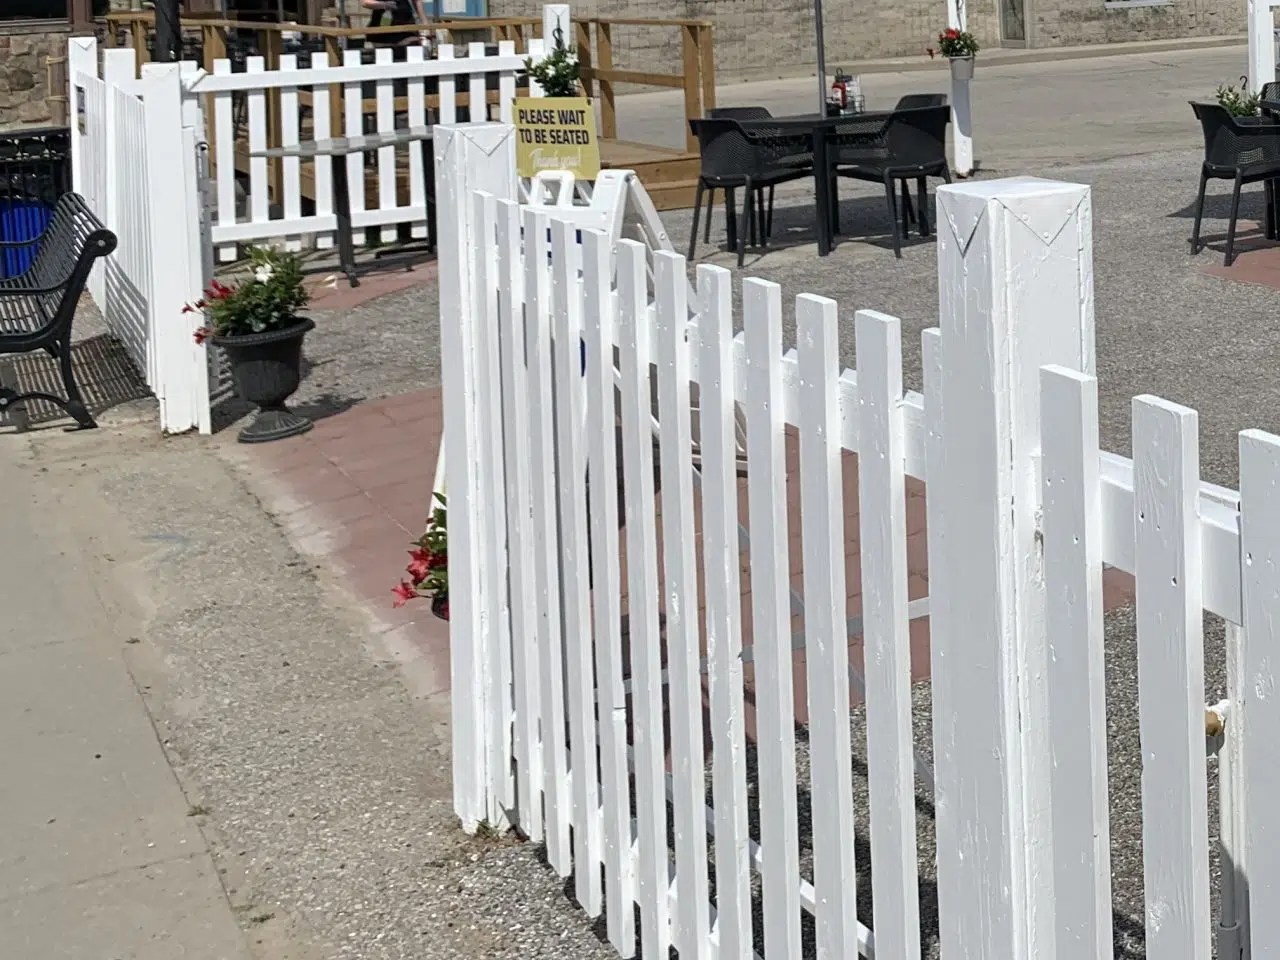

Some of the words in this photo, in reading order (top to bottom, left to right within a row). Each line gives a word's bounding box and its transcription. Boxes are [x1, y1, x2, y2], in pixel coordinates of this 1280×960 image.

[518, 109, 555, 125] PLEASE
[557, 110, 586, 125] WAIT
[519, 129, 532, 144] TO
[534, 129, 547, 144] BE
[549, 129, 589, 145] SEATED
